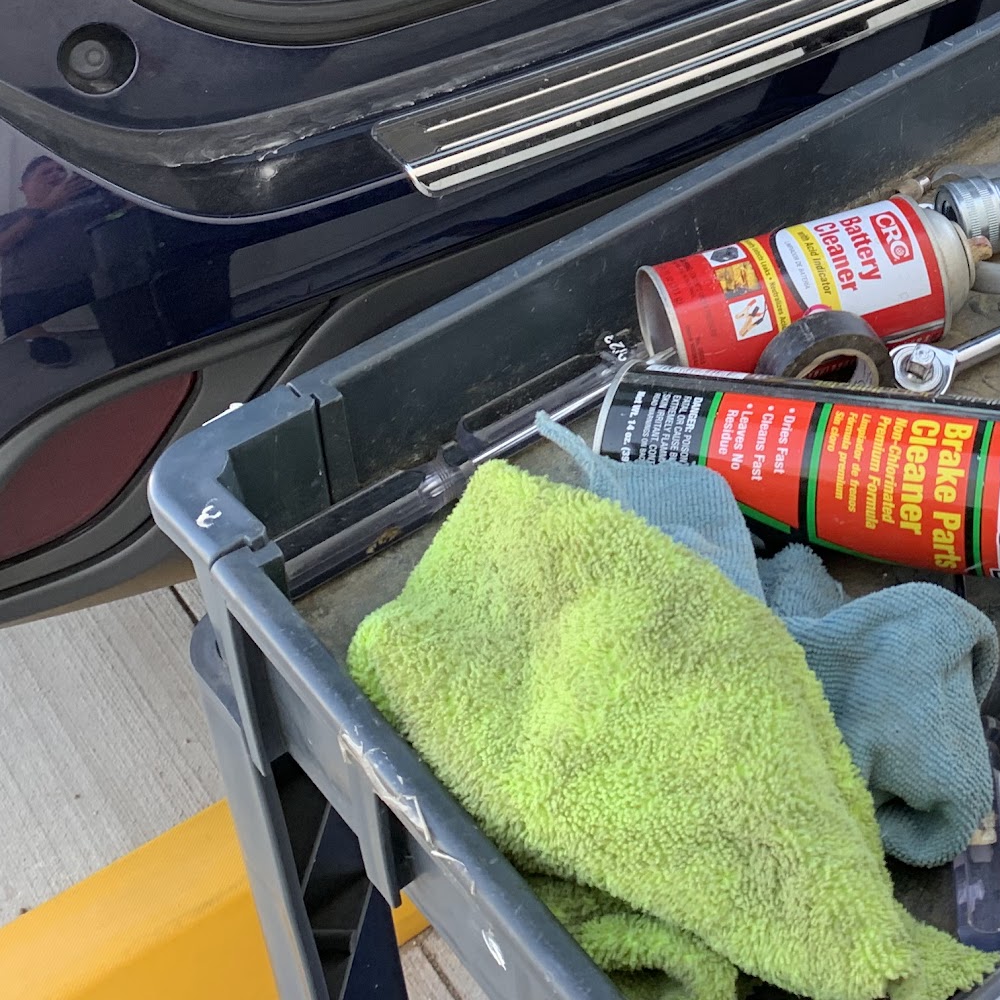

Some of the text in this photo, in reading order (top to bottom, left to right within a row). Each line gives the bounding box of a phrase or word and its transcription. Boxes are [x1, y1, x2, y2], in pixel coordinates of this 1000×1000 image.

[813, 222, 858, 291] Cleaner
[839, 215, 881, 280] Battery
[875, 213, 911, 261] CRC
[760, 261, 771, 276] Leaks
[769, 282, 787, 317] Neutralizes
[805, 240, 819, 258] Acid
[812, 257, 832, 296] Indicator
[633, 391, 647, 404] Net
[658, 393, 672, 409] SKIN
[664, 394, 682, 428] EXTREMELY
[674, 414, 685, 424] OR
[678, 395, 692, 413] FATAL
[684, 396, 703, 432] DANGER:
[623, 432, 633, 445] oz.
[626, 420, 636, 431] 14
[671, 425, 683, 450] CAUSE
[718, 409, 740, 455] Residue
[730, 411, 754, 471] Leaves No
[751, 413, 775, 482] Cleans Fast
[773, 415, 796, 474] Dries Fast
[826, 410, 845, 452] Sin cloro
[648, 444, 658, 465] CONT
[834, 451, 847, 500] premium
[847, 413, 872, 513] Limpiador de frenos
[865, 415, 892, 530] Premium Formula
[881, 417, 908, 524] Non-Chlorinated
[899, 420, 940, 536] Cleaner
[932, 422, 973, 569] Brake Parts
